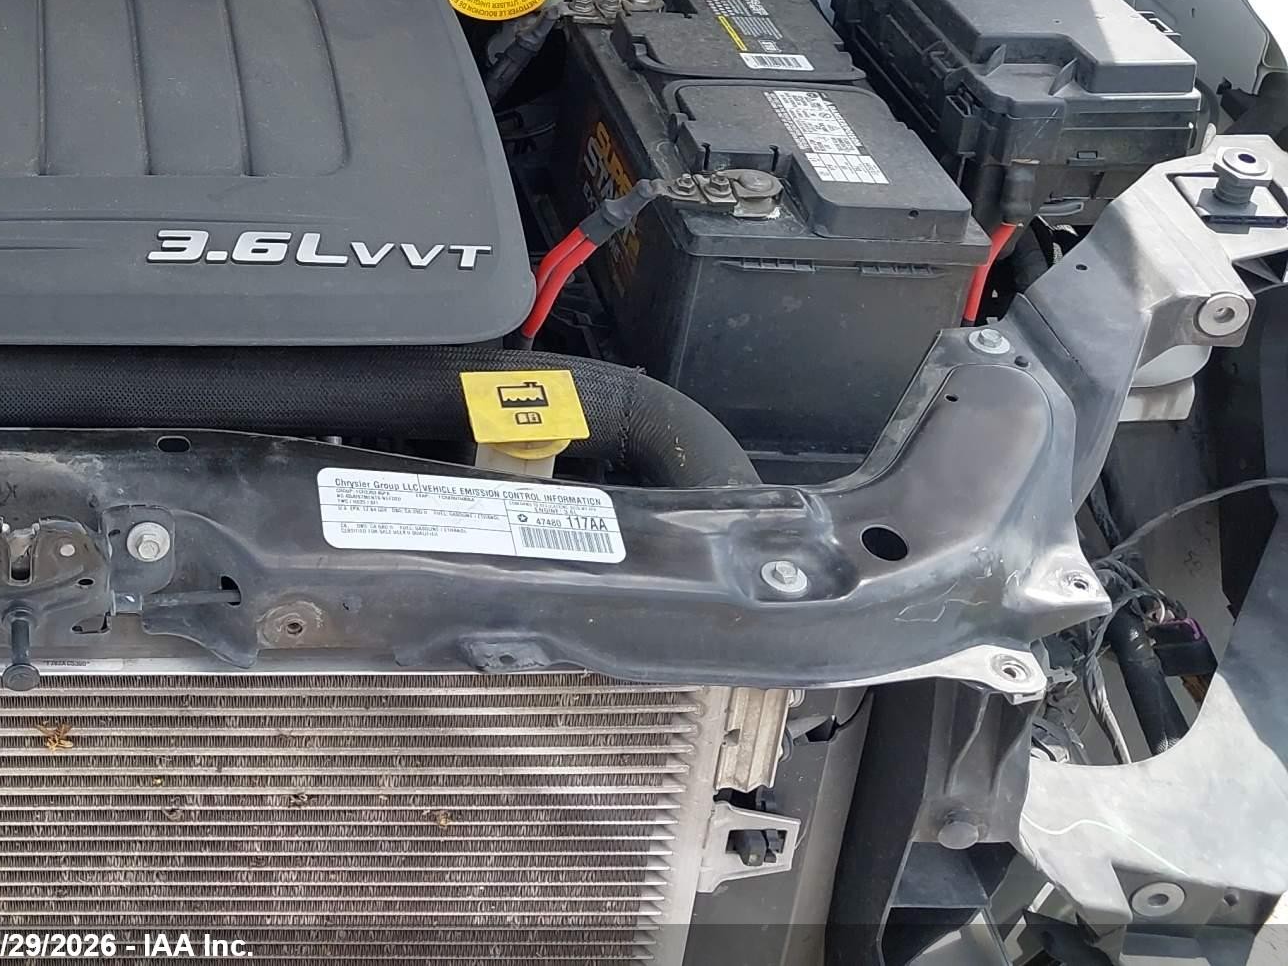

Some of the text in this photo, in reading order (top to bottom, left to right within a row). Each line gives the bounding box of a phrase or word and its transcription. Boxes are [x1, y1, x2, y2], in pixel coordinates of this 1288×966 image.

[146, 229, 492, 270] 3.6L VVT
[335, 478, 370, 489] Chrysler
[373, 480, 400, 492] Group
[402, 483, 418, 492] LLC
[422, 484, 457, 495] VEHICLE
[460, 487, 500, 498] EMISSION
[502, 490, 541, 502] CONTROL
[544, 493, 601, 506] INFORMATION
[566, 515, 608, 531] 117AA
